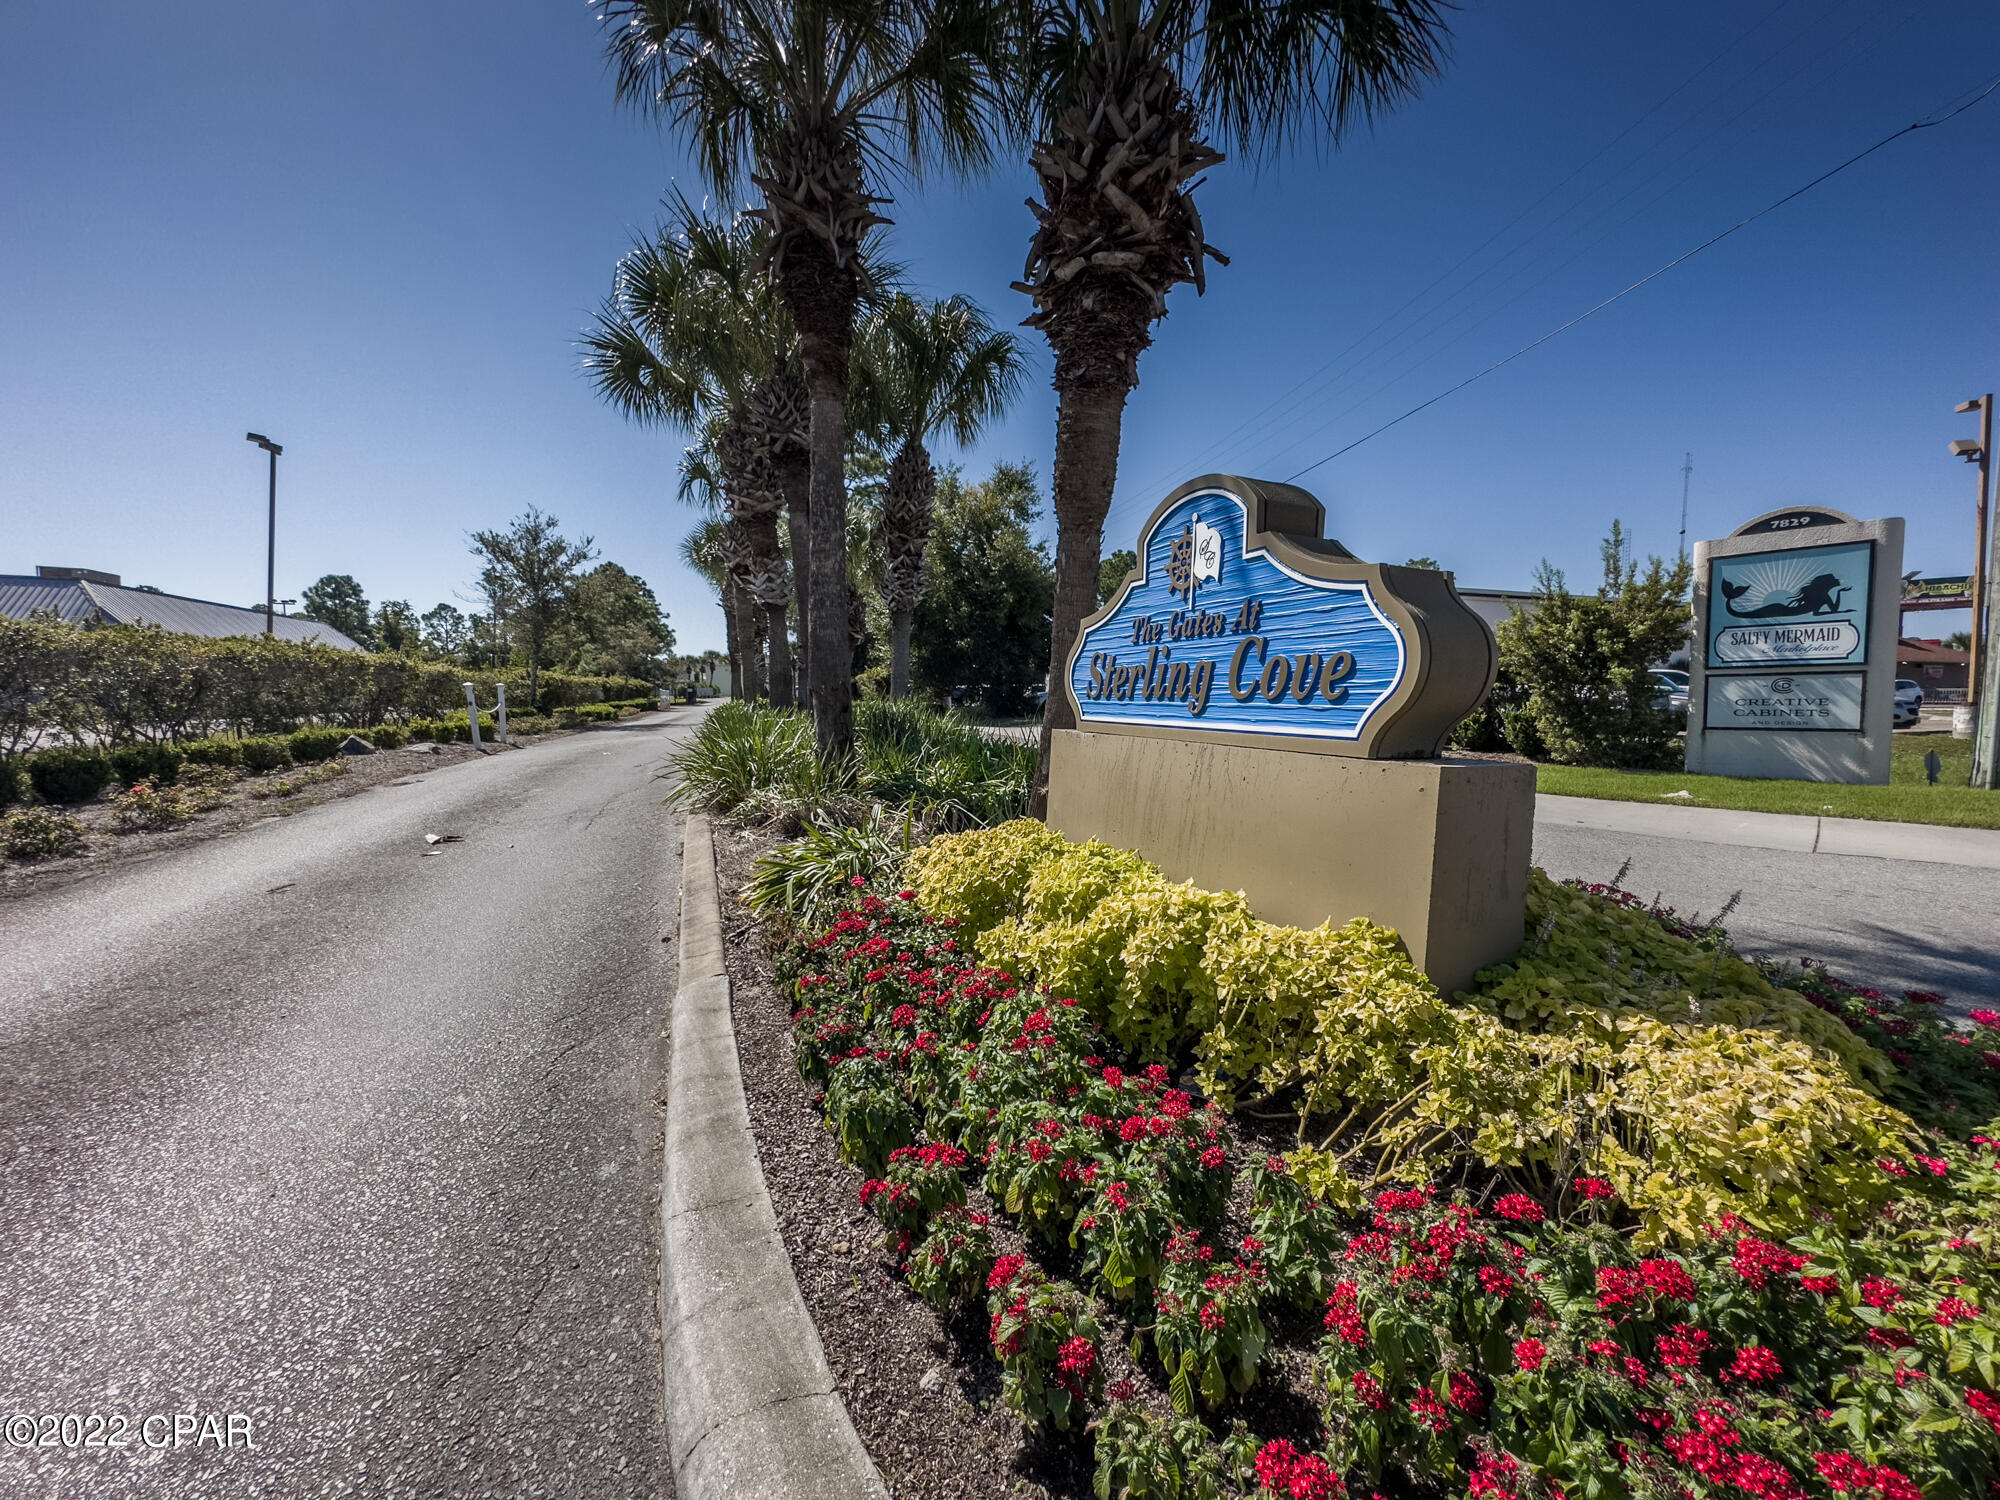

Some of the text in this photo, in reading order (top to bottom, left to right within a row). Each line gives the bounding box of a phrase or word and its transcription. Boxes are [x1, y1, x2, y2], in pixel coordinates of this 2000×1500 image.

[1770, 516, 1810, 529] 7829
[1131, 598, 1263, 645] The Gates At
[1730, 627, 1840, 646] SALTY MERMAID
[1087, 636, 1357, 716] Sterling Cove
[1734, 697, 1830, 707] CREATIVE
[1733, 708, 1830, 718] CABINETS
